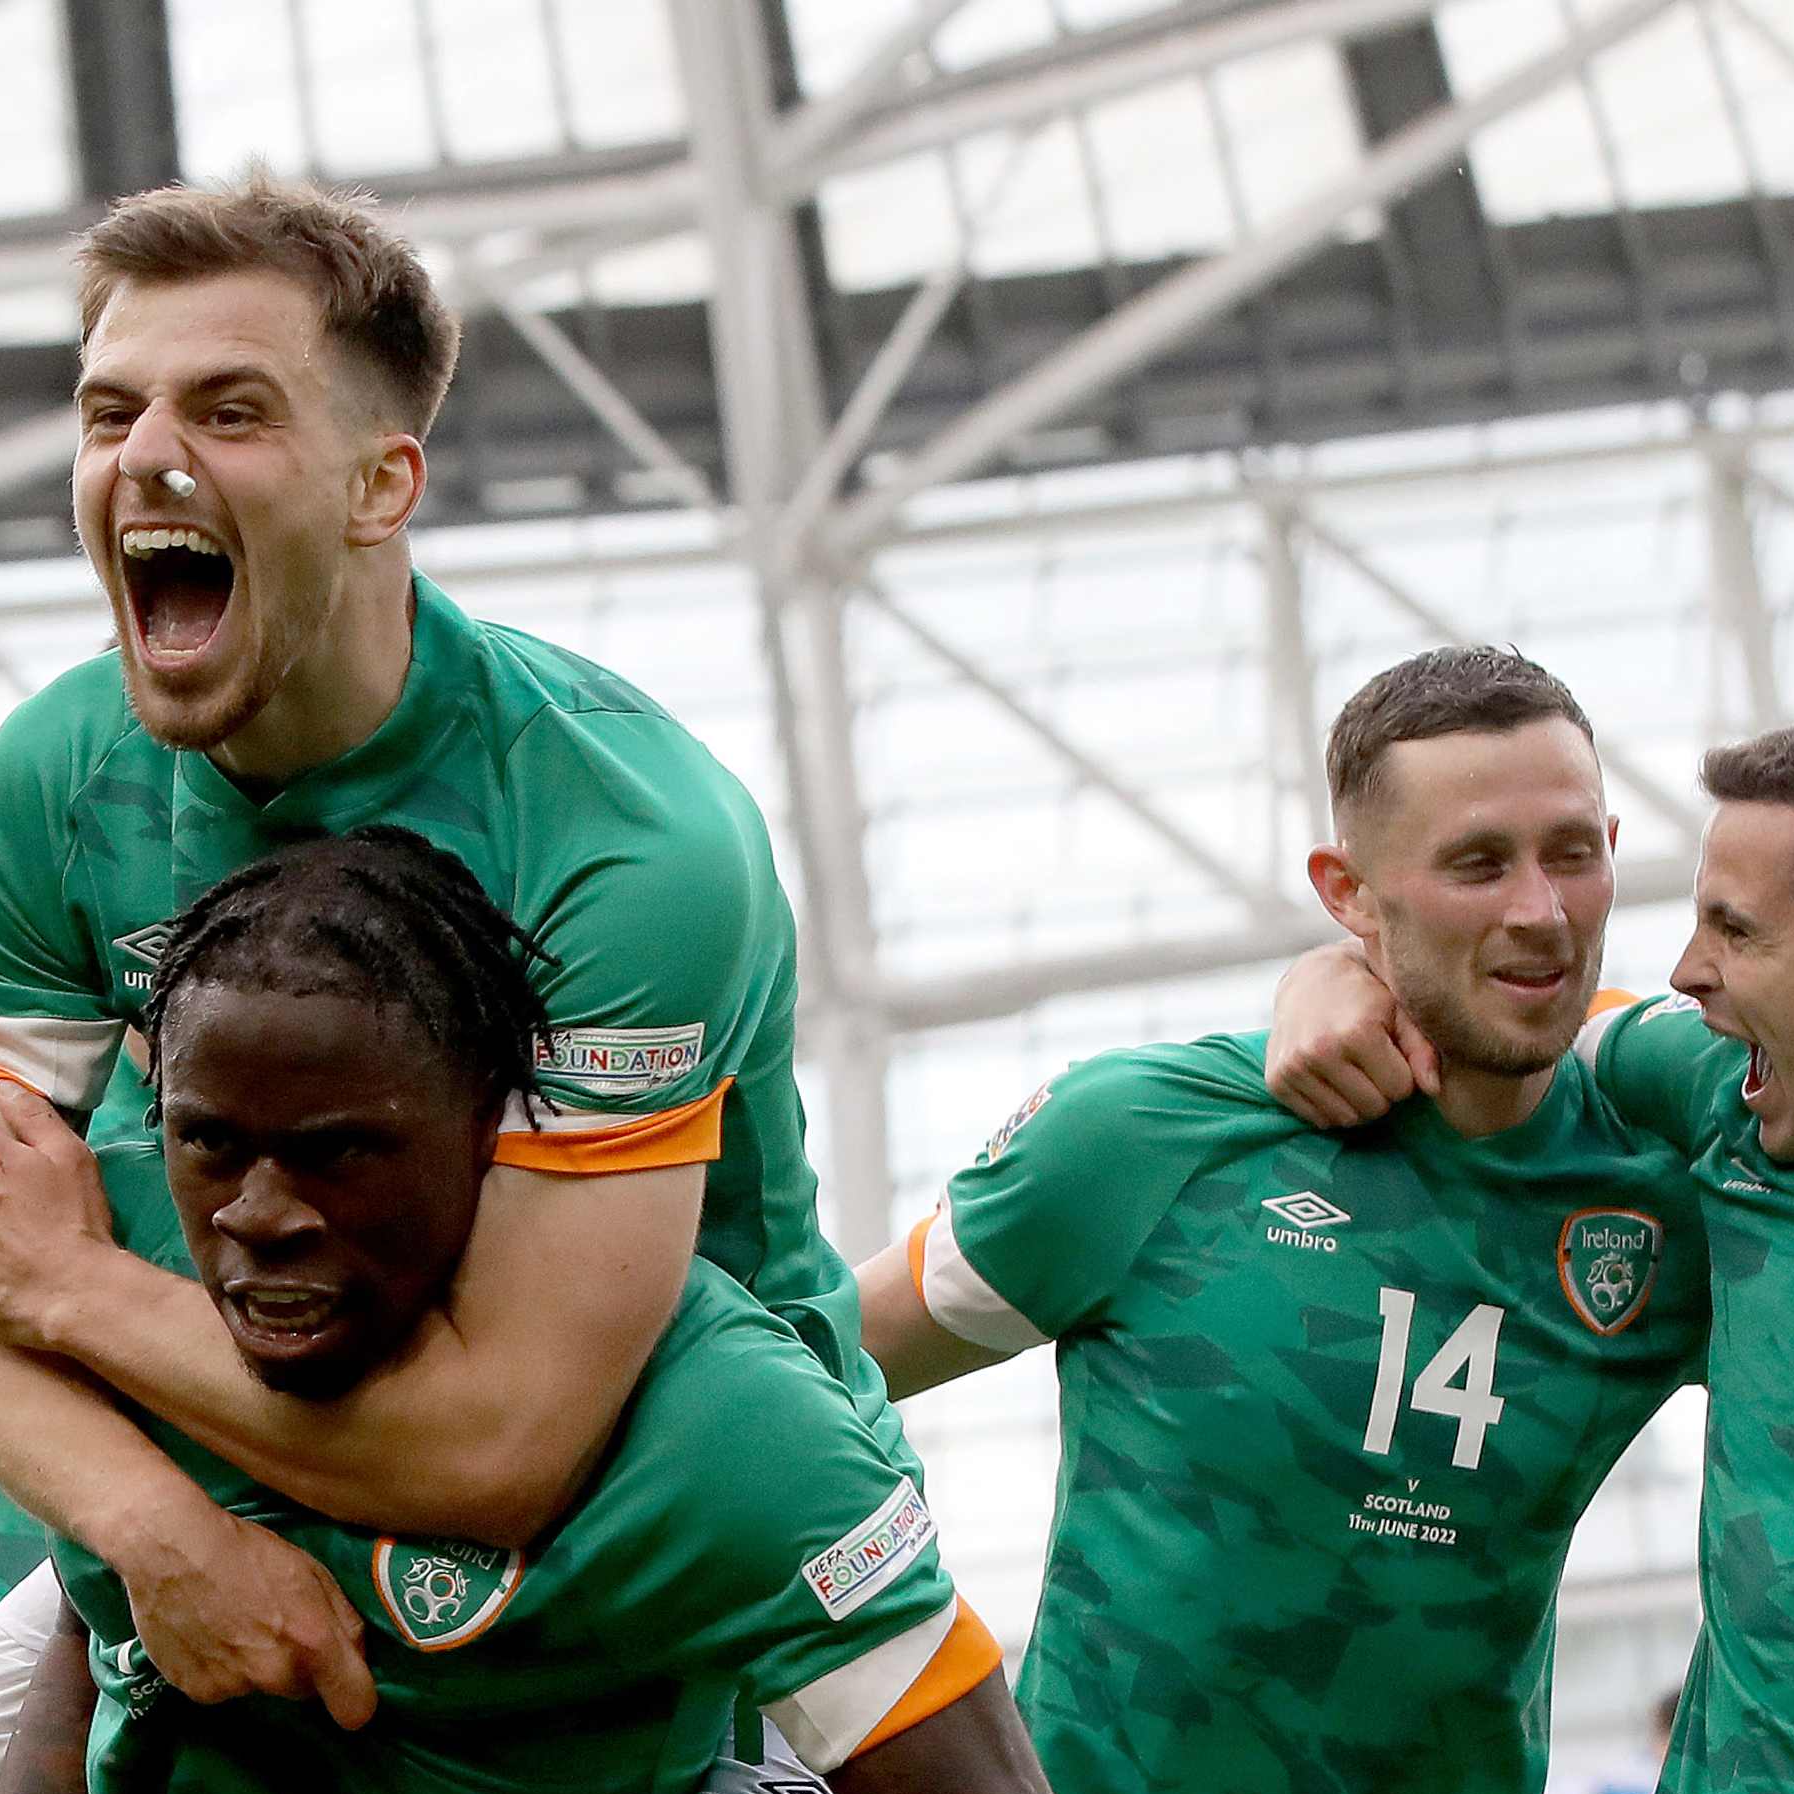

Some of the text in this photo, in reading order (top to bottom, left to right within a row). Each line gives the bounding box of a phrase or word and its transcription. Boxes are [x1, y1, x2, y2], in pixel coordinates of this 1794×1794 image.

[1267, 1226, 1337, 1253] umbro
[1580, 1225, 1646, 1250] Ireland
[1362, 1286, 1506, 1470] 14
[1363, 1493, 1451, 1521] SCOTLAND
[1376, 1518, 1419, 1539] JUNE
[1419, 1525, 1457, 1545] 2022
[808, 1548, 845, 1579] UEFA
